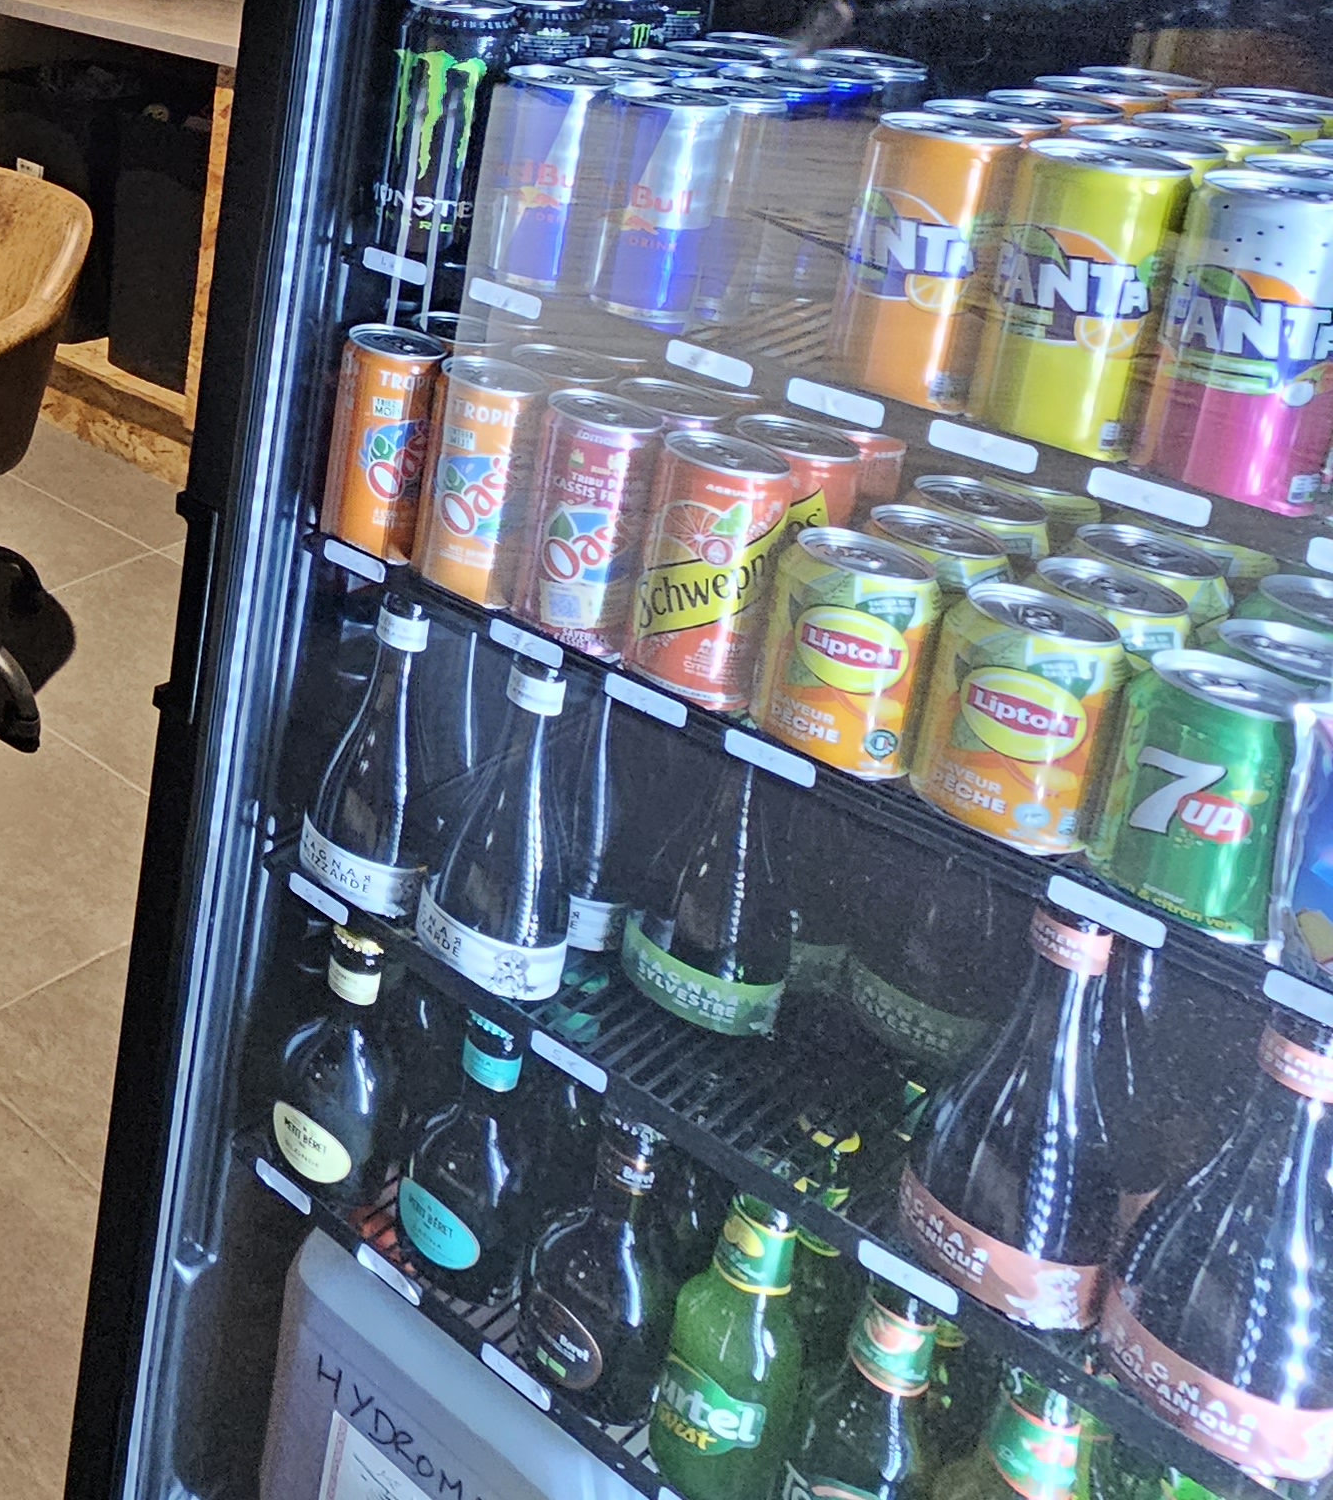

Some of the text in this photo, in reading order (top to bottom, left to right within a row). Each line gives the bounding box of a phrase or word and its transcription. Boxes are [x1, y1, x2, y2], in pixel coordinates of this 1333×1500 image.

[807, 626, 895, 667] Lipton
[974, 688, 1070, 735] Lipton
[1151, 891, 1203, 922] citron
[637, 960, 737, 1018] SYLVESTRE
[317, 1353, 483, 1500] HYDROM
